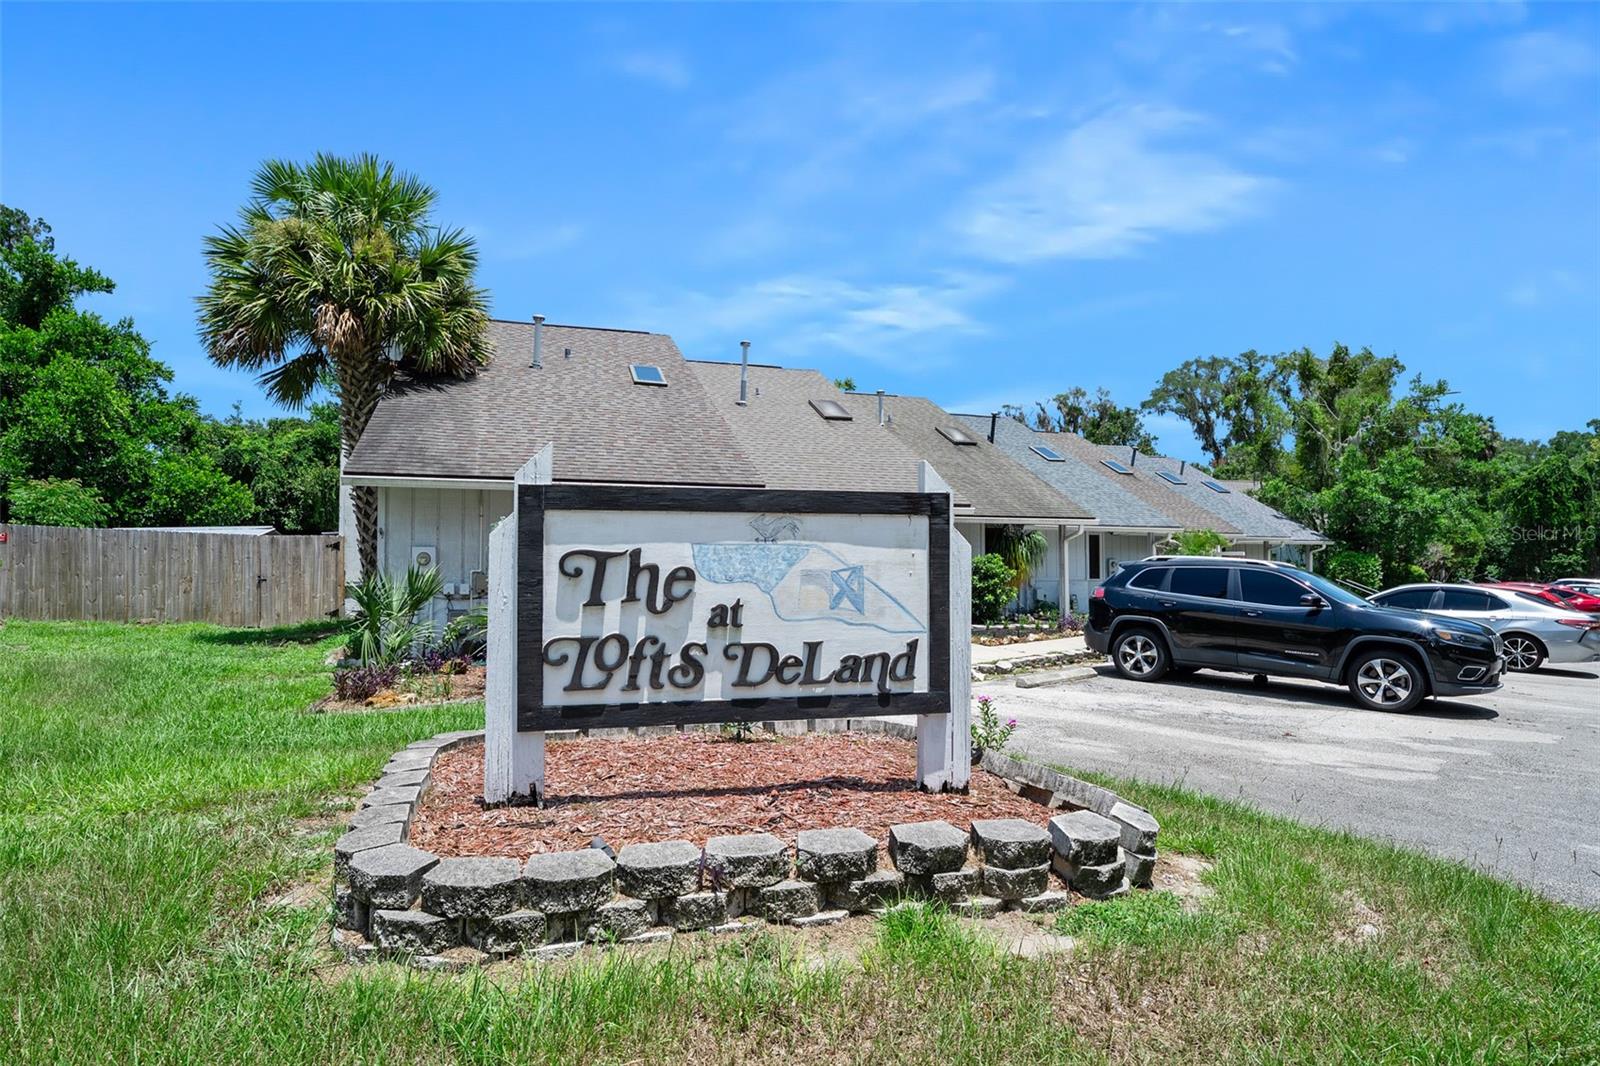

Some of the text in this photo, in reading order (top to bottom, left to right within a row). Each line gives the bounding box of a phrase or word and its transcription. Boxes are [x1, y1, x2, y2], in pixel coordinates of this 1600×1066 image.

[559, 548, 696, 615] The
[707, 598, 744, 628] at
[723, 638, 919, 692] DeLand
